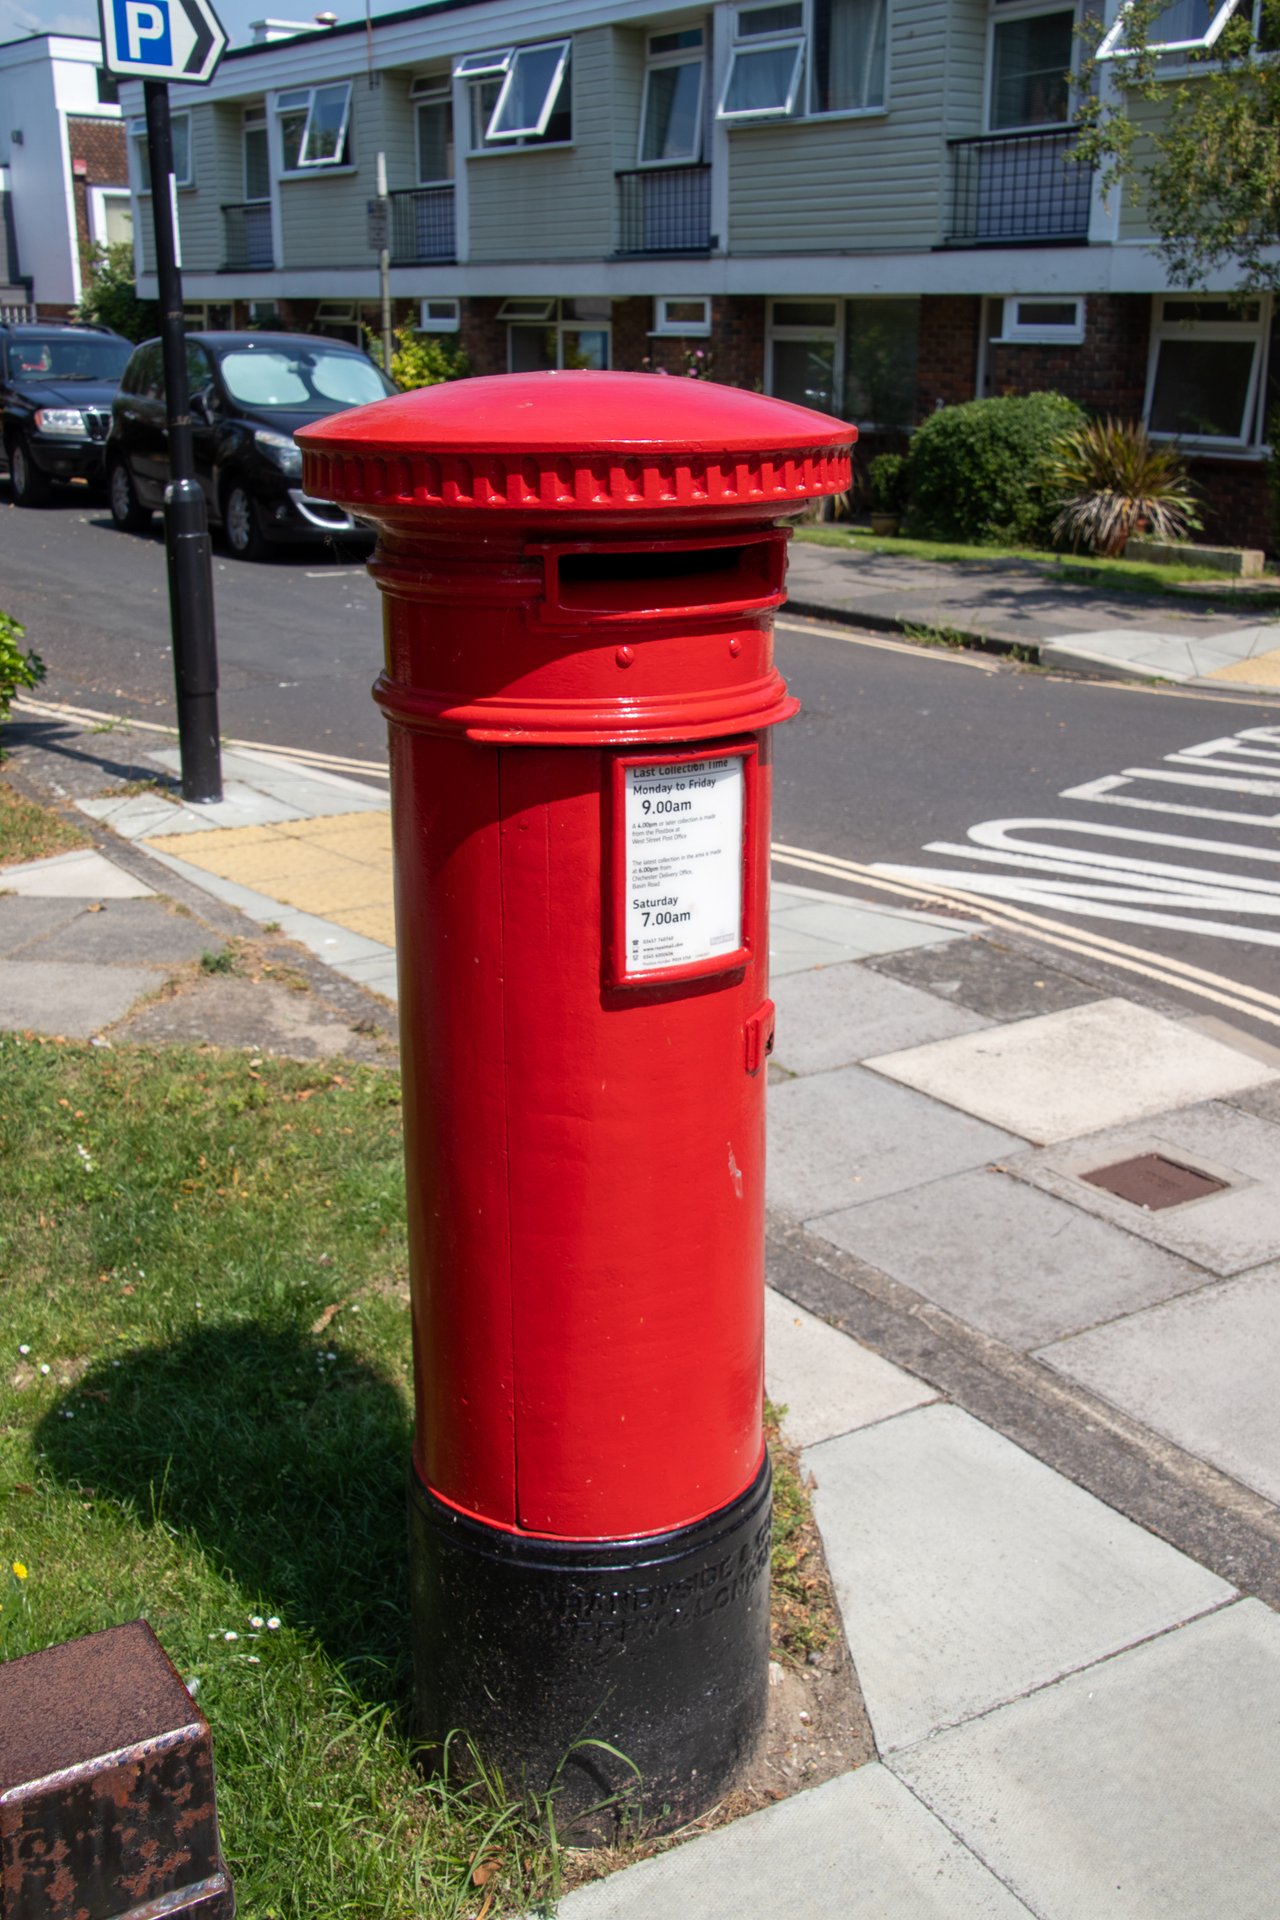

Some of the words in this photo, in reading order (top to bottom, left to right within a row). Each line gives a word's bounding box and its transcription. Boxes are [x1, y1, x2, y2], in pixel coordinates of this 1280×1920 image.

[125, 1, 165, 59] P
[633, 768, 655, 778] Last
[658, 763, 705, 776] Collection
[633, 783, 672, 795] Monday
[676, 782, 685, 791] to
[689, 778, 716, 790] Friday
[642, 800, 692, 815] 9.00am
[633, 896, 678, 909] Saturday
[641, 911, 691, 927] 7.00am
